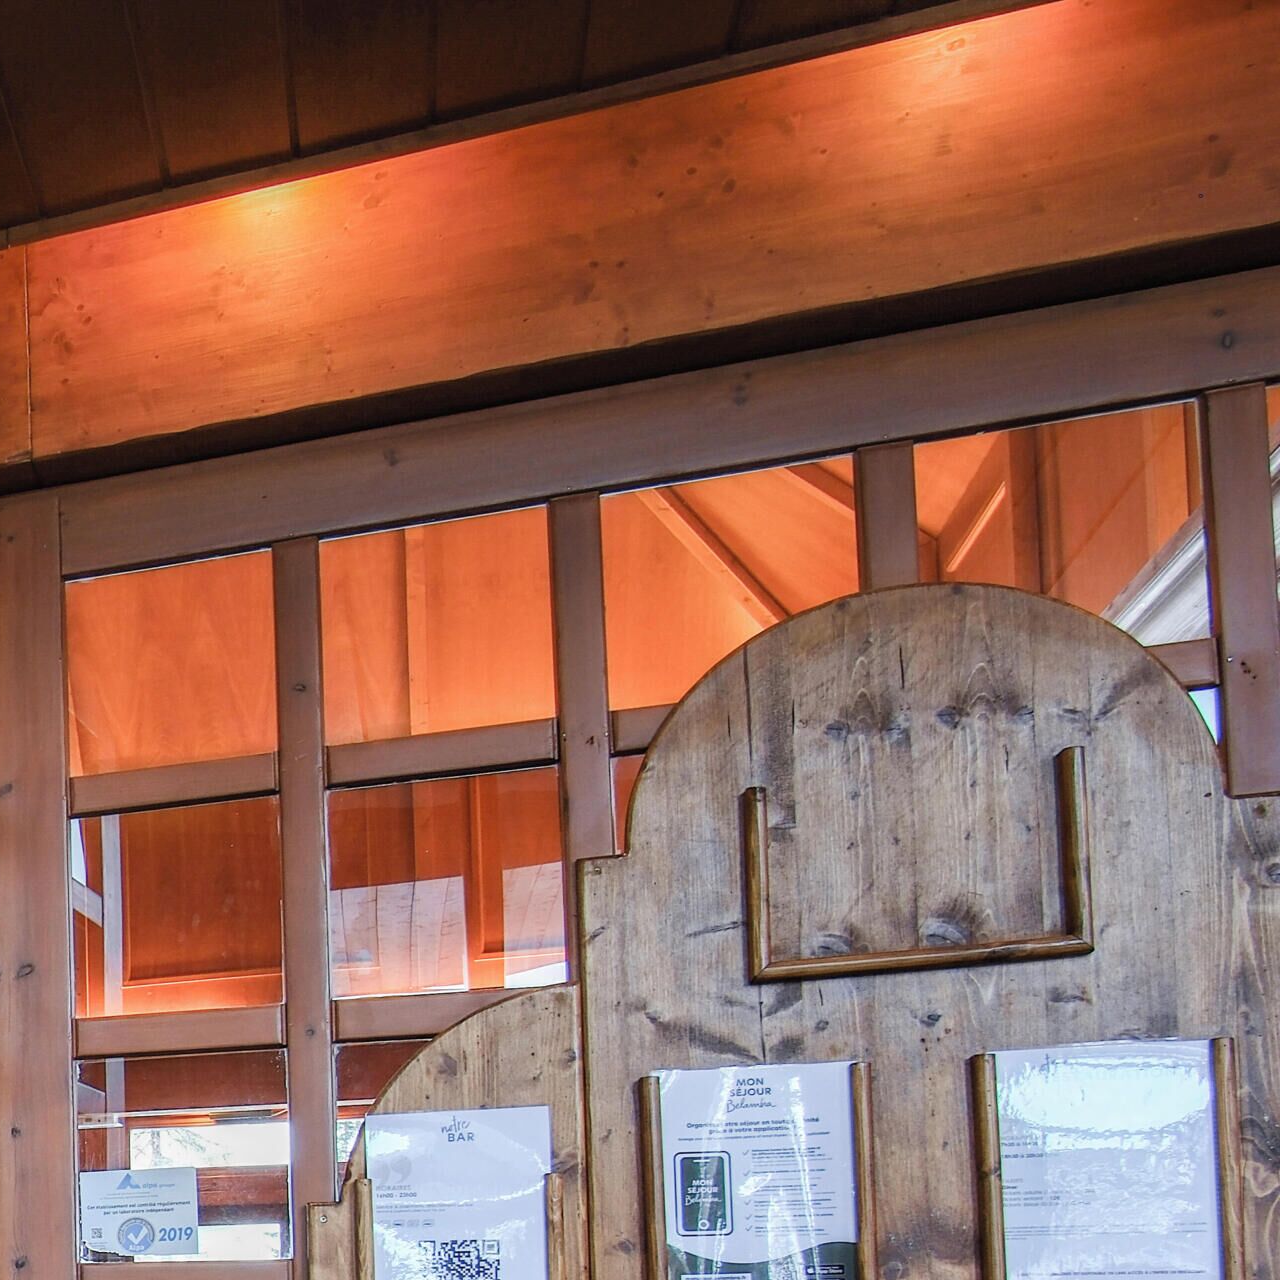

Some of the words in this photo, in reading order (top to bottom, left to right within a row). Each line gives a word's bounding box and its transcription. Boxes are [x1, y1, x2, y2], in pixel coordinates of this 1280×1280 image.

[736, 1078, 764, 1087] MON
[729, 1086, 772, 1097] SÉJOUR
[441, 1115, 471, 1134] notre
[447, 1132, 476, 1142] BAR
[158, 1226, 194, 1242] 2019
